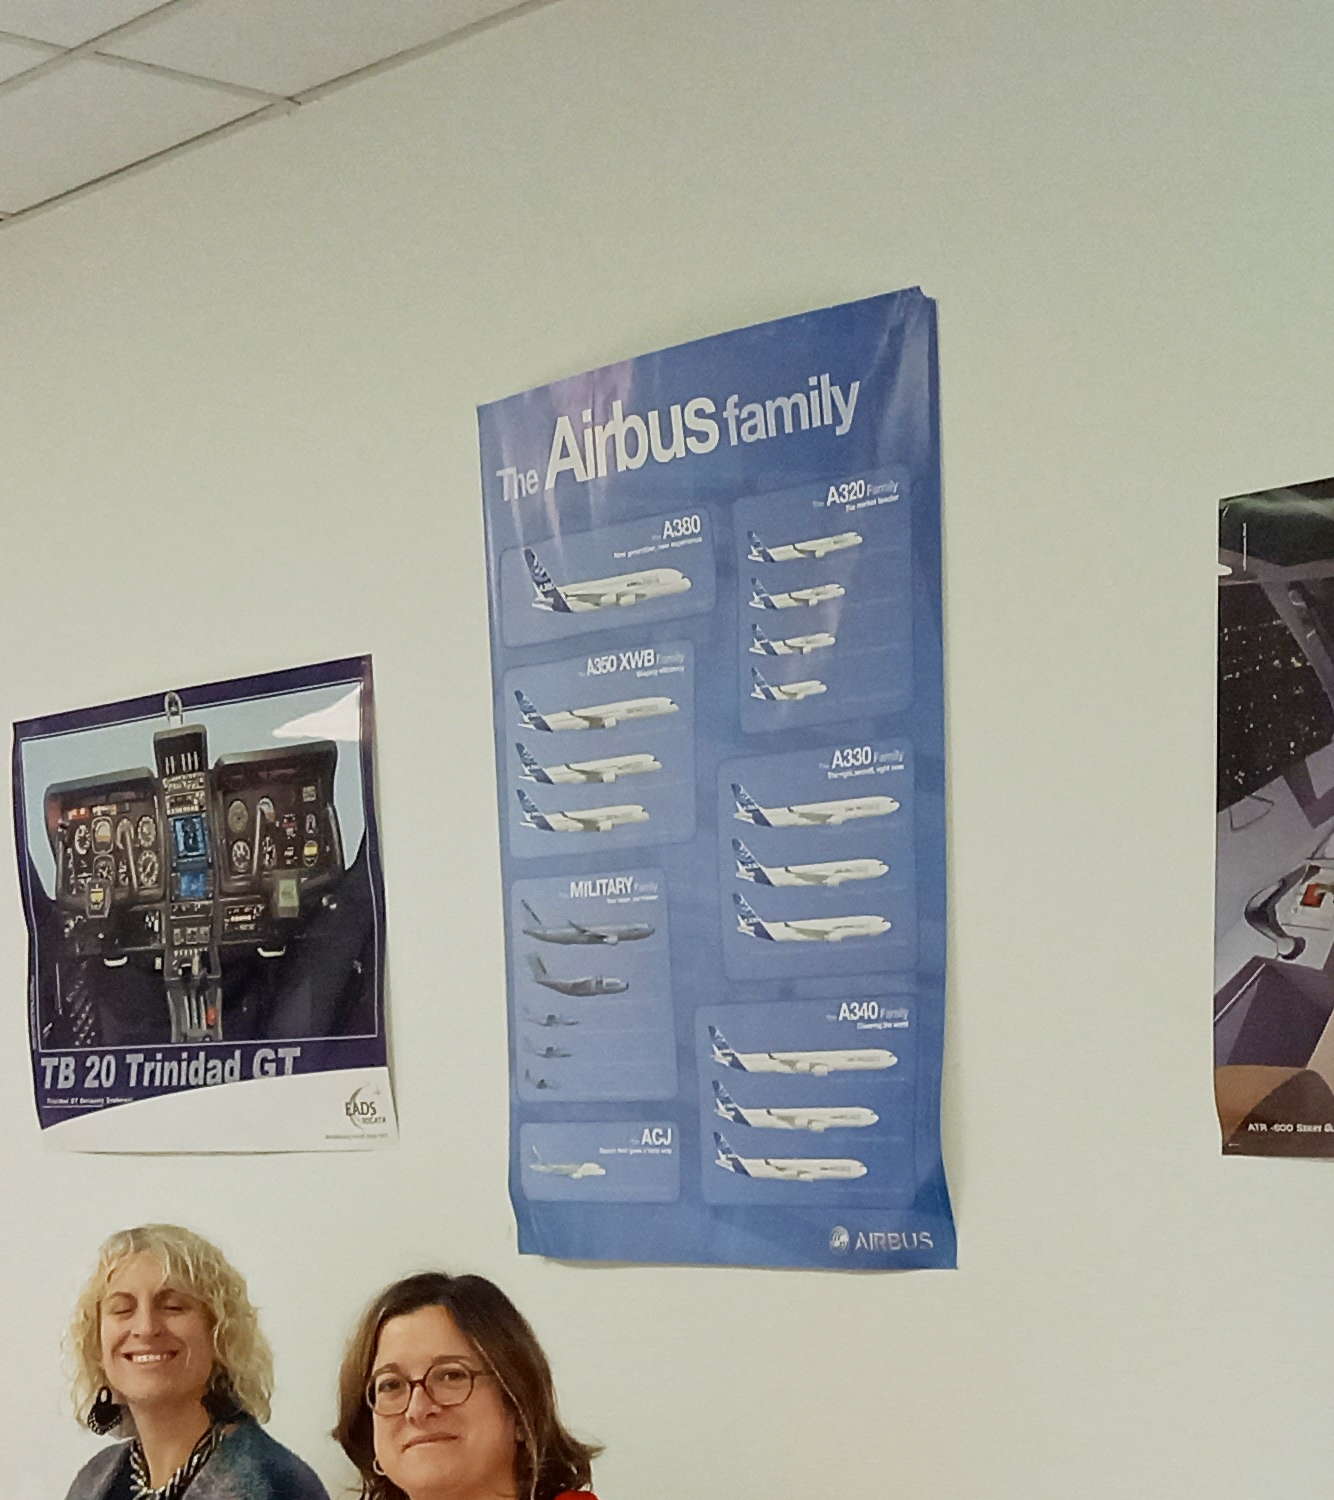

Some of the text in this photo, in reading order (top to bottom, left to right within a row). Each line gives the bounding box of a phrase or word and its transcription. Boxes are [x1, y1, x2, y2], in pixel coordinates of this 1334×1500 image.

[496, 373, 860, 501] The Airbus family
[826, 480, 865, 507] A320
[663, 514, 701, 539] A380
[586, 655, 617, 677] A350
[619, 648, 655, 671] XWB
[831, 745, 872, 769] A330
[570, 876, 633, 898] MILITARY
[838, 1001, 879, 1021] A340
[40, 1046, 301, 1089] TB 20 Trinidad GT
[345, 1101, 377, 1116] EADS
[641, 1127, 672, 1146] ACJ
[1247, 1122, 1267, 1132] ATR
[855, 1231, 934, 1251] AIRBUS
